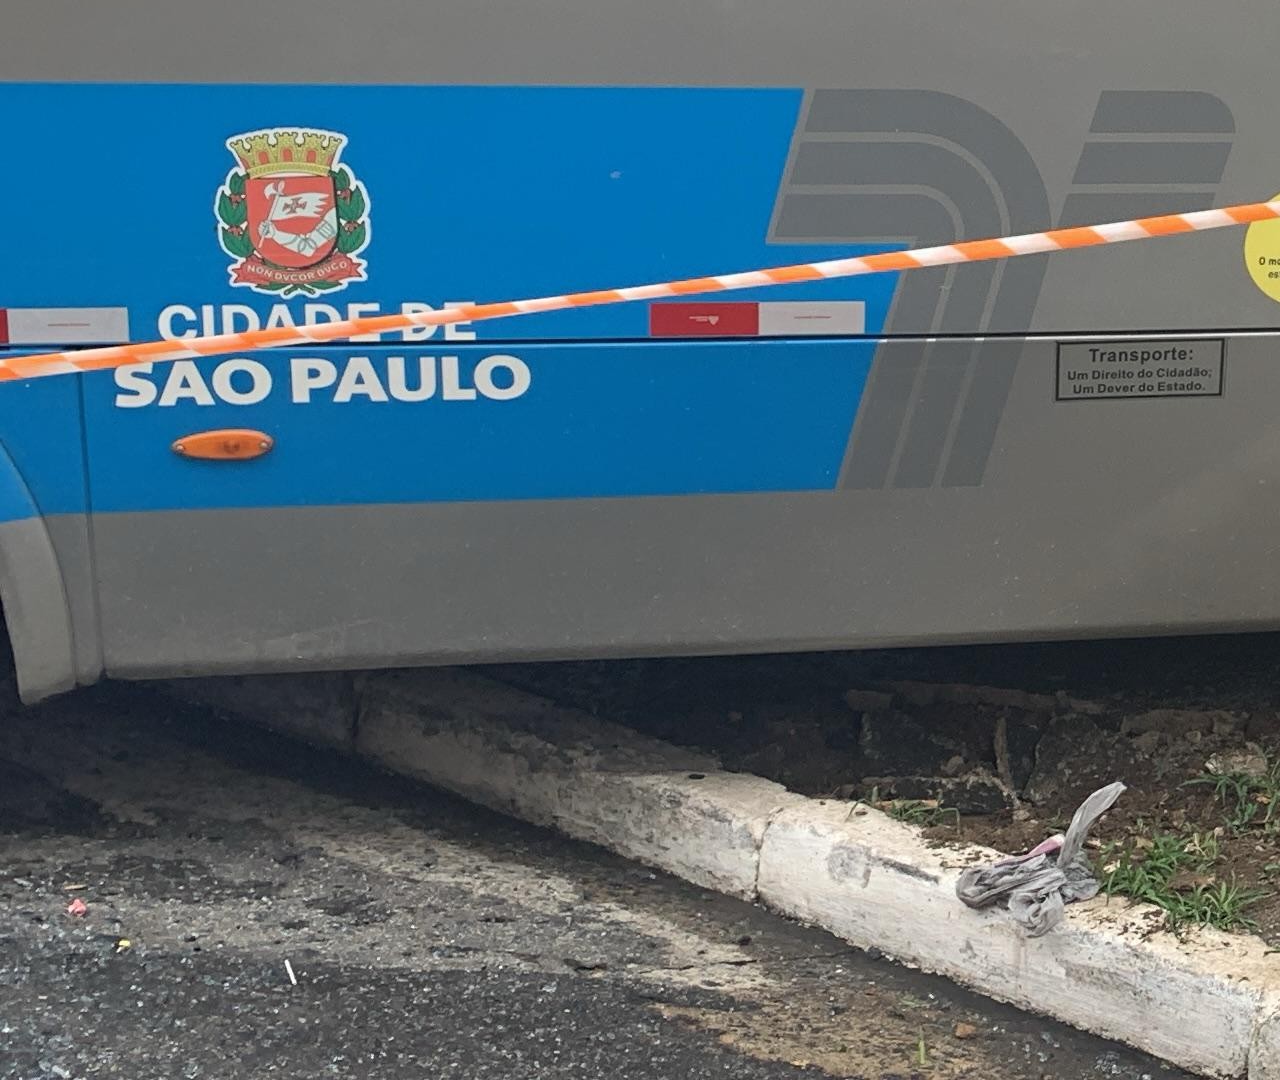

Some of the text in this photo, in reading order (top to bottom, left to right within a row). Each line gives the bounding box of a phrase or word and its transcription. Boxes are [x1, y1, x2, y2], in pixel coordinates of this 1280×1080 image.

[1258, 256, 1266, 266] O
[246, 264, 273, 279] NON
[401, 301, 477, 342] DE
[1089, 347, 1194, 365] Transporte:
[290, 354, 531, 404] PAULO
[1067, 370, 1089, 381] Um
[1092, 369, 1134, 380] Direito
[1137, 368, 1153, 379] do
[1073, 381, 1206, 394] Um Dever do Estado.
